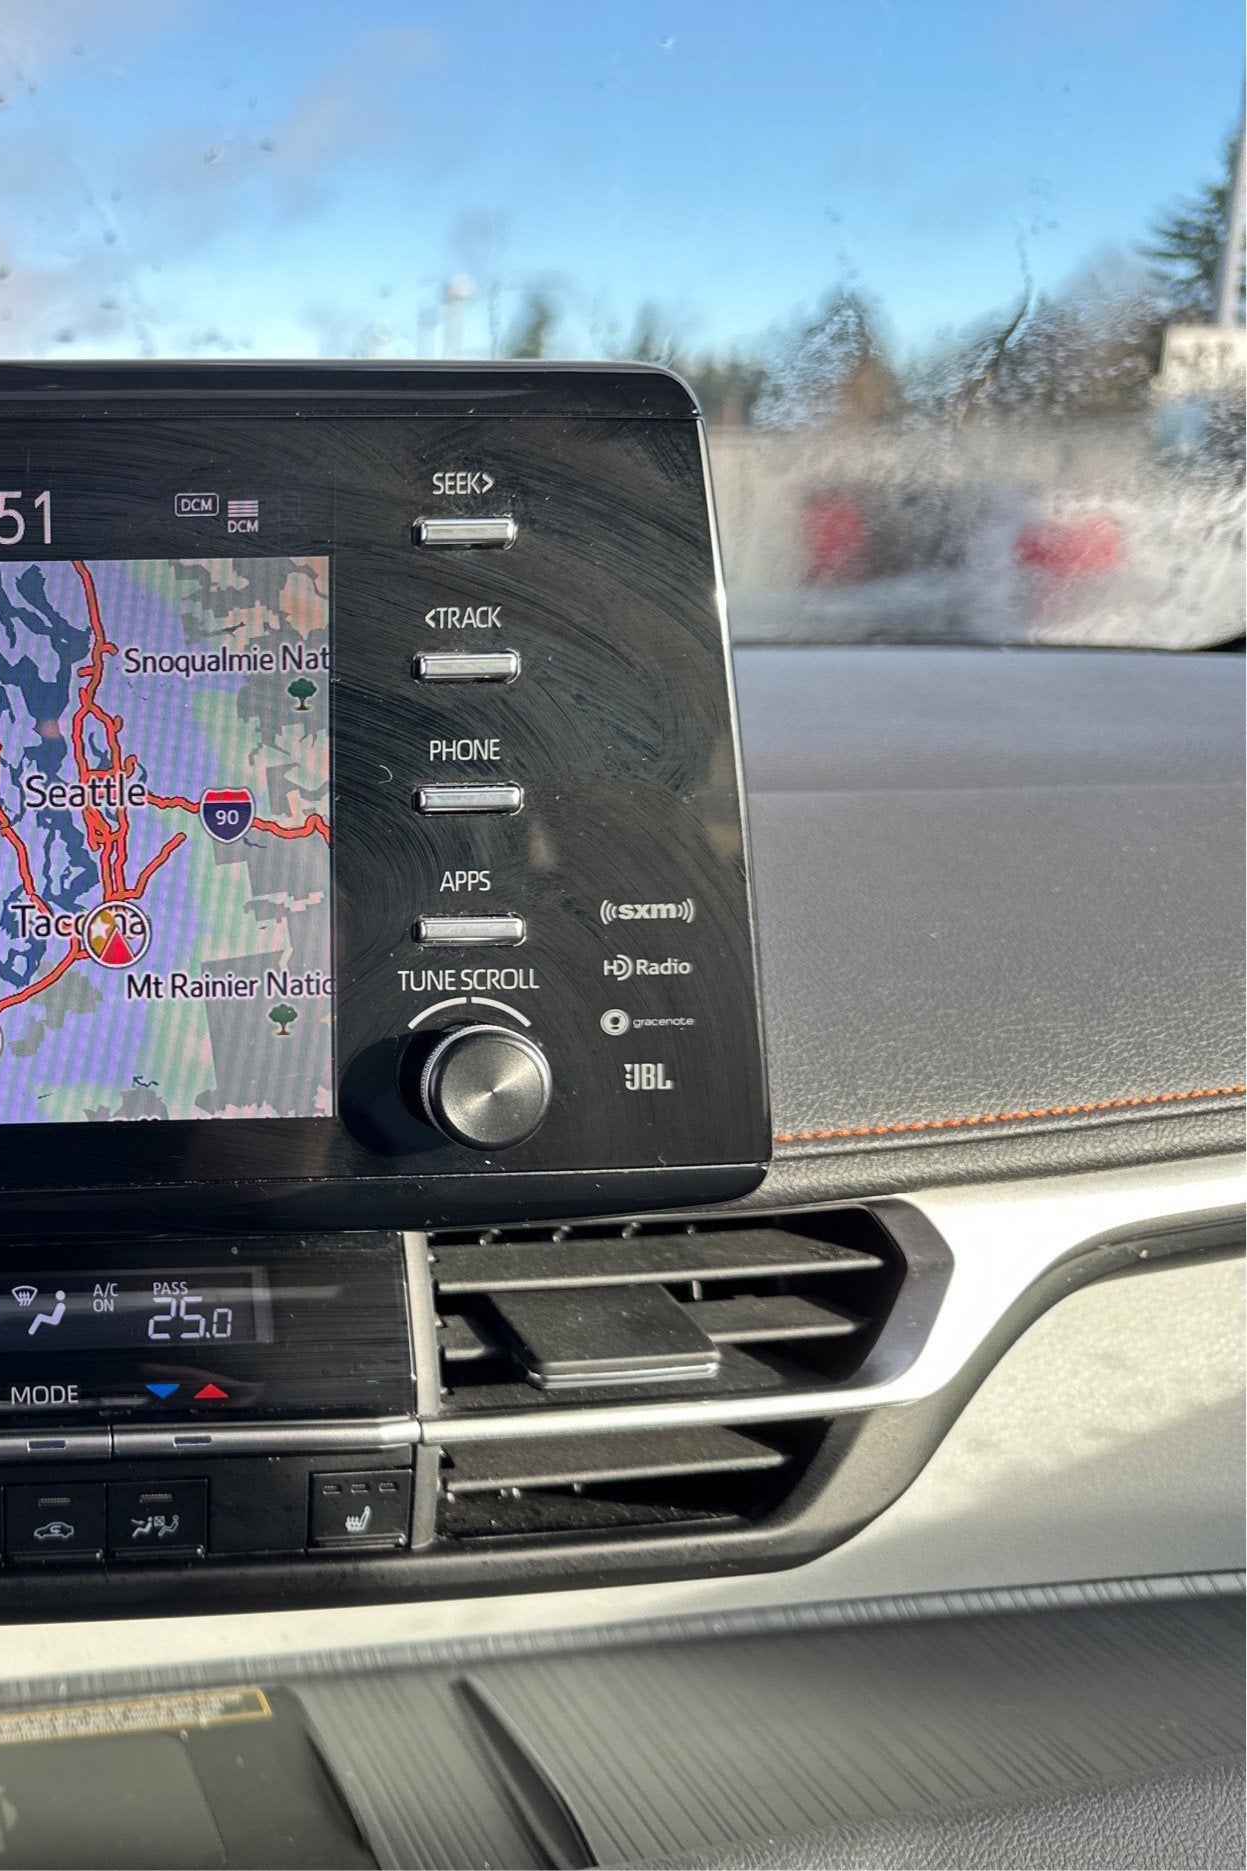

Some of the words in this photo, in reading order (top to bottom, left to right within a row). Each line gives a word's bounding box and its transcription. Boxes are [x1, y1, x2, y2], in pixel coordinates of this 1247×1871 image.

[180, 496, 213, 513] DCM
[227, 520, 259, 533] DCM
[124, 650, 274, 678] Snoqualmie
[282, 645, 330, 672] Nat
[429, 739, 500, 761] PHONE
[27, 773, 146, 809] Seattle
[214, 808, 239, 826] 90
[440, 871, 491, 892] APPS
[603, 954, 633, 981] HD
[635, 957, 693, 975] Radio
[127, 974, 163, 999] Mt
[171, 974, 259, 998] Rainier
[398, 970, 456, 991] TUNE
[461, 968, 540, 990] SCROLL
[633, 1018, 693, 1028] gracenote
[625, 1063, 673, 1090] JBL
[93, 1283, 119, 1297] A/C
[153, 1282, 189, 1295] PASS
[93, 1298, 115, 1312] ON
[148, 1296, 233, 1339] 25.0
[11, 1385, 79, 1405] MODE
